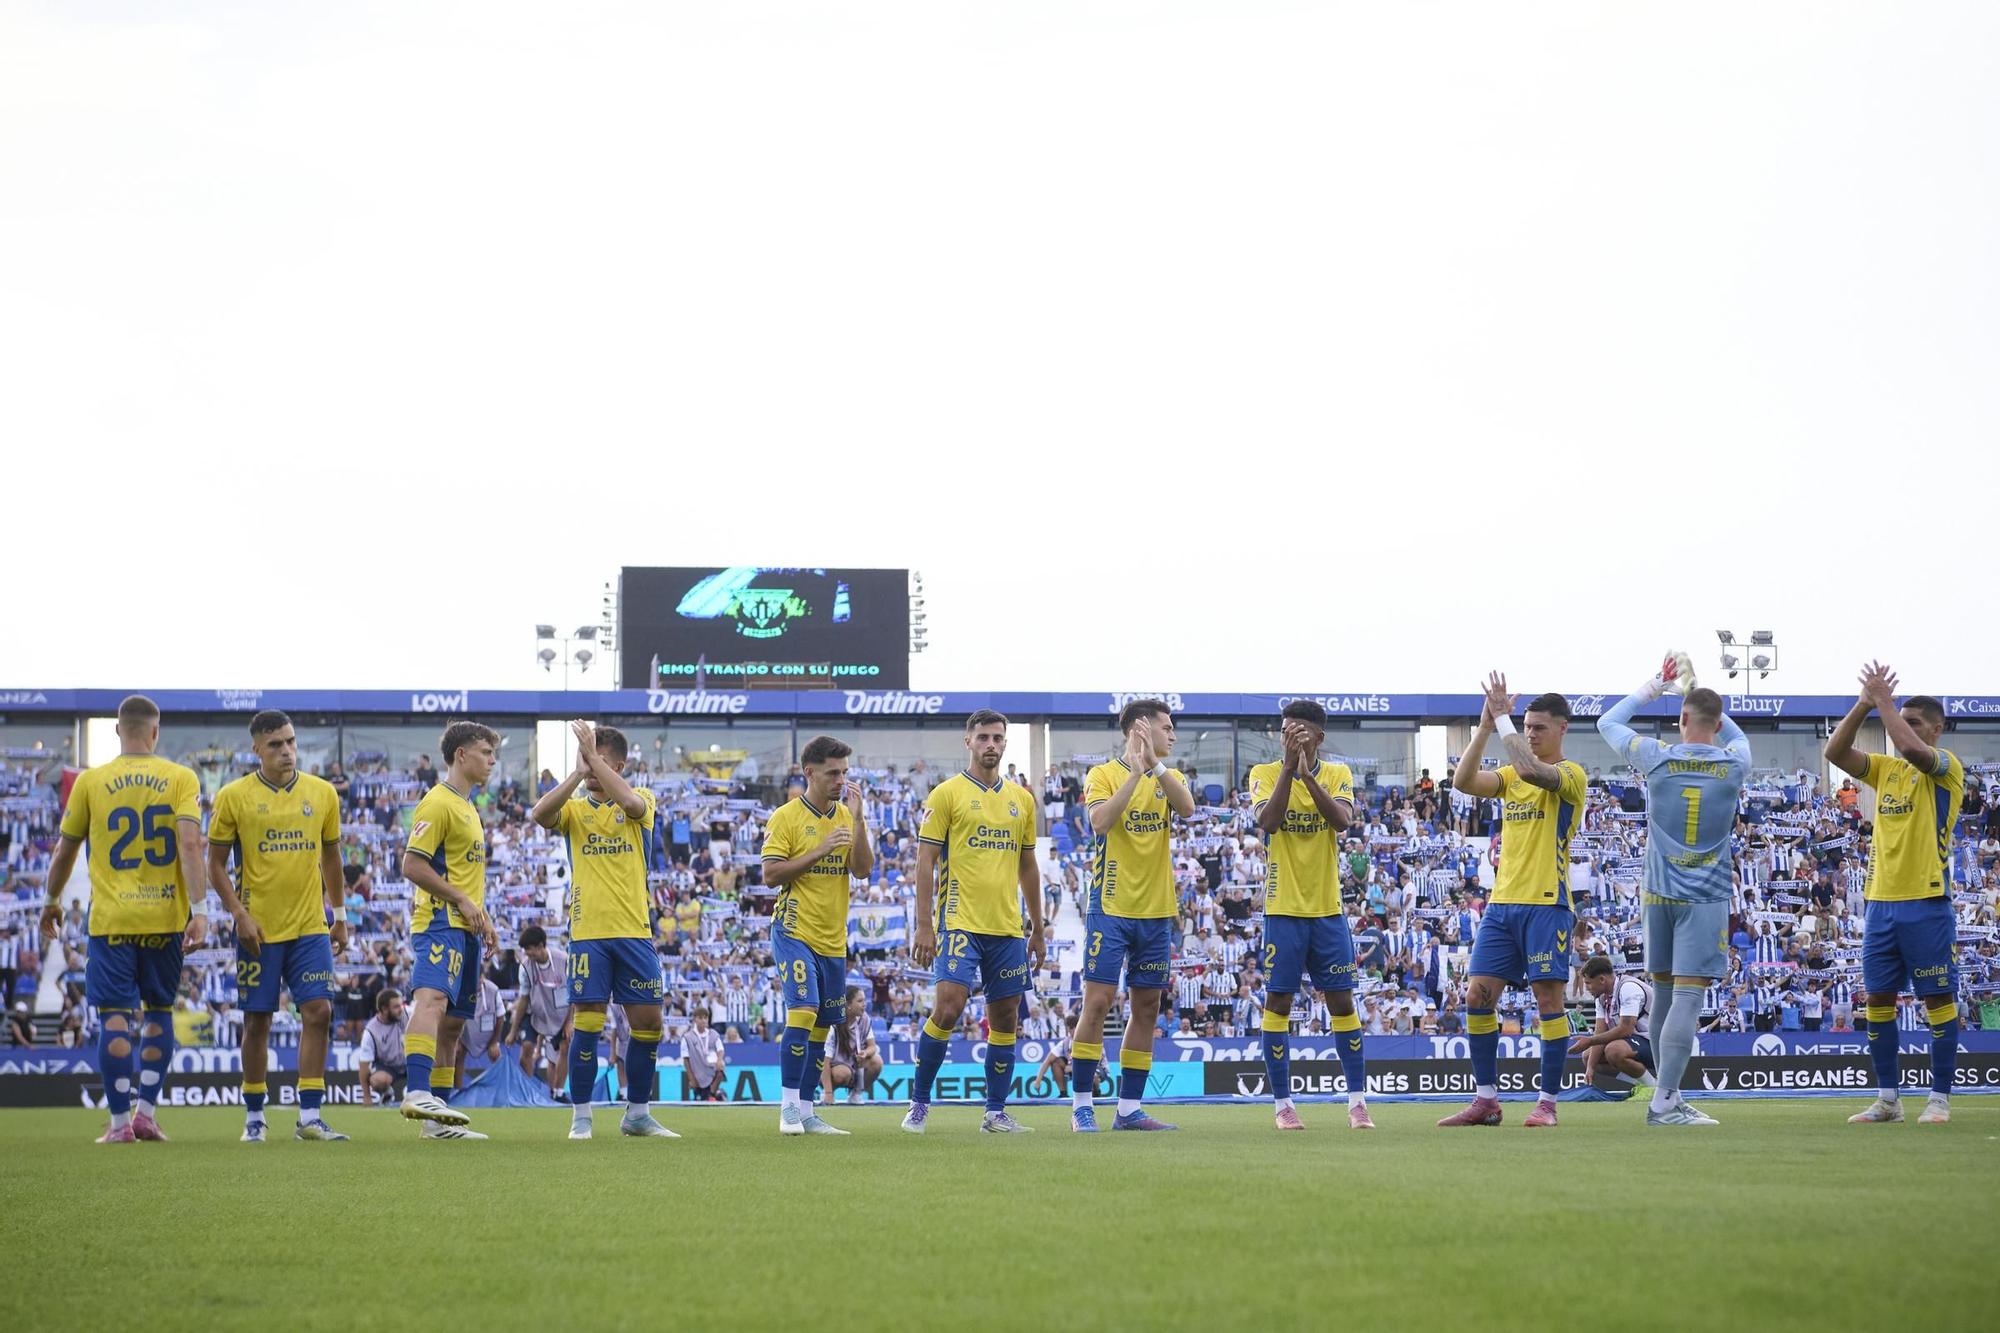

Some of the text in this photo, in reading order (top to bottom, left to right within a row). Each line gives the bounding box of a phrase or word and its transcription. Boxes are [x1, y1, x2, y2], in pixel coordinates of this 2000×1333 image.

[658, 664, 880, 676] EMOTRANDO CON SU JUEGO
[646, 689, 748, 713] Ontime
[844, 690, 943, 714] Ontime
[1729, 696, 1784, 716] Ebury
[105, 773, 169, 795] LUKOVIĆ
[1129, 810, 1160, 821] Gran
[1286, 810, 1319, 822] Gran
[1506, 807, 1545, 821] anaria
[1680, 787, 1701, 846] 1
[107, 804, 177, 871] 25
[265, 829, 303, 840] Gran
[977, 825, 1011, 838] Gran
[258, 840, 316, 853] Canaria
[582, 842, 633, 856] Canaria
[968, 837, 1018, 852] Canari
[819, 854, 843, 864] ran
[948, 933, 969, 958] 12
[1088, 931, 1103, 957] 3
[571, 952, 590, 979] 14
[1264, 943, 1277, 969] 2
[237, 961, 261, 987] 22
[793, 959, 807, 984] 8
[1914, 964, 1948, 978] Cordial
[1290, 1072, 1588, 1093] DLEGNÉS BUSINSS CUB
[1738, 1066, 1868, 1088] CDLEGANÉS
